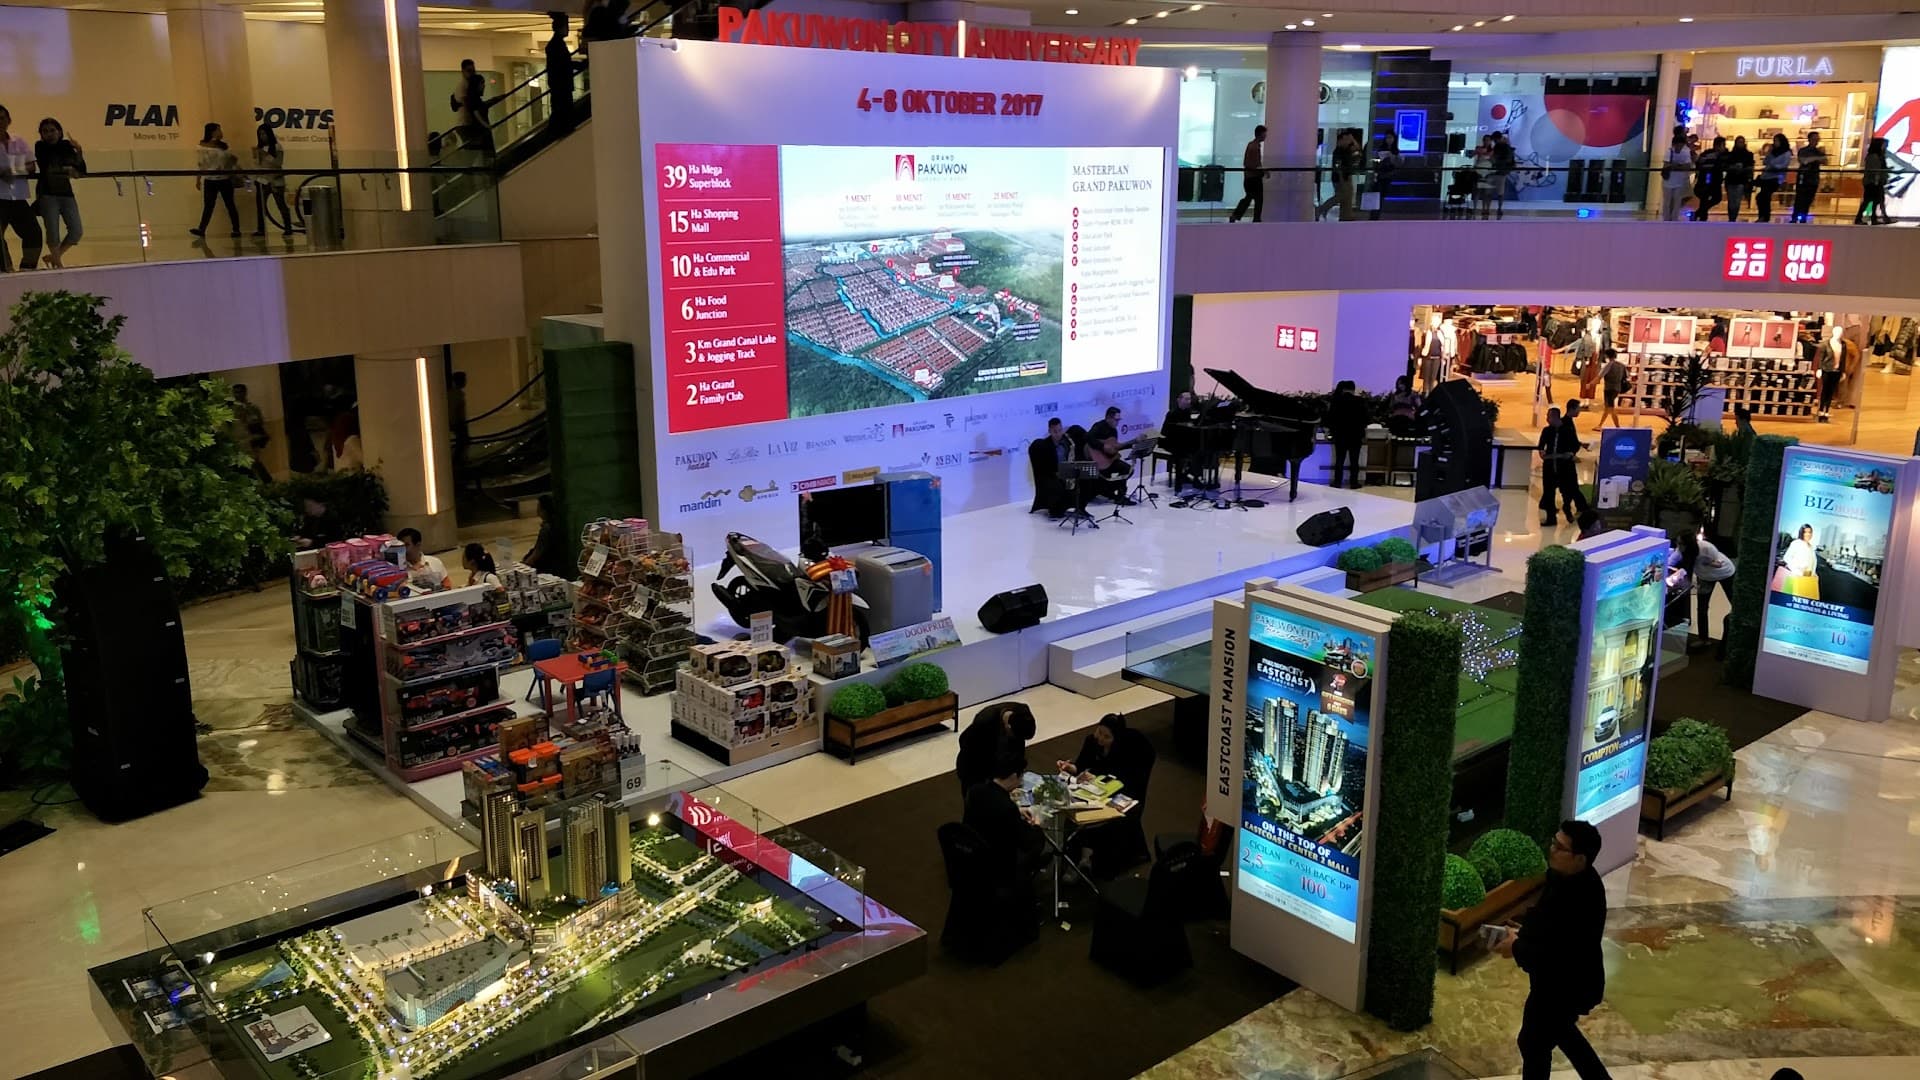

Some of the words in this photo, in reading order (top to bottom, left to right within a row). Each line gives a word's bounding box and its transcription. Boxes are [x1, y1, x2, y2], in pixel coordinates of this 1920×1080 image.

[718, 6, 888, 53] PAKUWON
[893, 21, 959, 56] CITY
[965, 27, 1142, 66] ANNIVERSARY
[1736, 57, 1834, 78] FURLA
[856, 87, 897, 113] 4-8
[902, 89, 997, 116] OKTOBER
[1000, 93, 1044, 117] 2017
[663, 165, 688, 189] 39
[688, 165, 700, 175] Ha
[701, 165, 723, 176] Mega
[918, 163, 968, 175] PAKUWON
[1072, 165, 1129, 176] MASTERPLAN
[689, 178, 732, 191] Superblock
[1072, 181, 1106, 192] GRAND
[1108, 179, 1152, 192] PAKUWON
[668, 210, 690, 233] 15
[690, 209, 703, 219] Ha
[704, 208, 739, 221] Shopping
[691, 223, 710, 233] Mall
[693, 253, 705, 264] Ha
[705, 251, 750, 263] Commercial
[1787, 244, 1824, 262] UNI
[670, 255, 692, 278] 10
[694, 266, 702, 277] &
[702, 266, 718, 276] Edu
[719, 265, 736, 276] Park
[1784, 262, 1825, 281] QLO
[695, 296, 706, 306] Ha
[707, 295, 727, 305] Food
[681, 299, 694, 321] 6
[696, 309, 728, 320] Junction
[697, 340, 712, 350] Km
[713, 337, 737, 349] Grand
[737, 335, 758, 346] Canal
[759, 334, 777, 345] Lake
[685, 342, 697, 364] 3
[698, 353, 706, 363] &
[707, 352, 736, 364] Jogging
[736, 348, 756, 359] Track
[699, 382, 711, 391] Ha
[711, 379, 735, 391] Grand
[686, 384, 699, 406] 2
[699, 393, 725, 405] Family
[726, 391, 744, 402] Club
[675, 450, 719, 467] PAKUWON
[679, 496, 722, 514] mandiri
[1804, 494, 1835, 511] BIZ
[1792, 596, 1810, 605] NEW
[1810, 599, 1846, 613] CONCEPT
[1793, 603, 1821, 614] BUSINESS
[1827, 610, 1850, 620] LIVING
[1222, 628, 1236, 703] MANSION
[1257, 662, 1310, 688] EASTCOAST
[1219, 704, 1233, 797] EASTCOAST
[1583, 741, 1620, 765] COMPTON
[626, 776, 642, 790] 69
[1244, 820, 1287, 847] EASTCOAST
[1288, 842, 1319, 862] CENTER
[1327, 860, 1351, 875] MALL
[1261, 820, 1276, 834] ON
[1277, 827, 1296, 843] THE
[1298, 834, 1316, 851] TOP
[1317, 843, 1332, 858] OF
[1289, 858, 1312, 875] CASH
[1313, 867, 1337, 885] BACK
[1339, 880, 1352, 892] DP
[1300, 875, 1327, 900] 100
